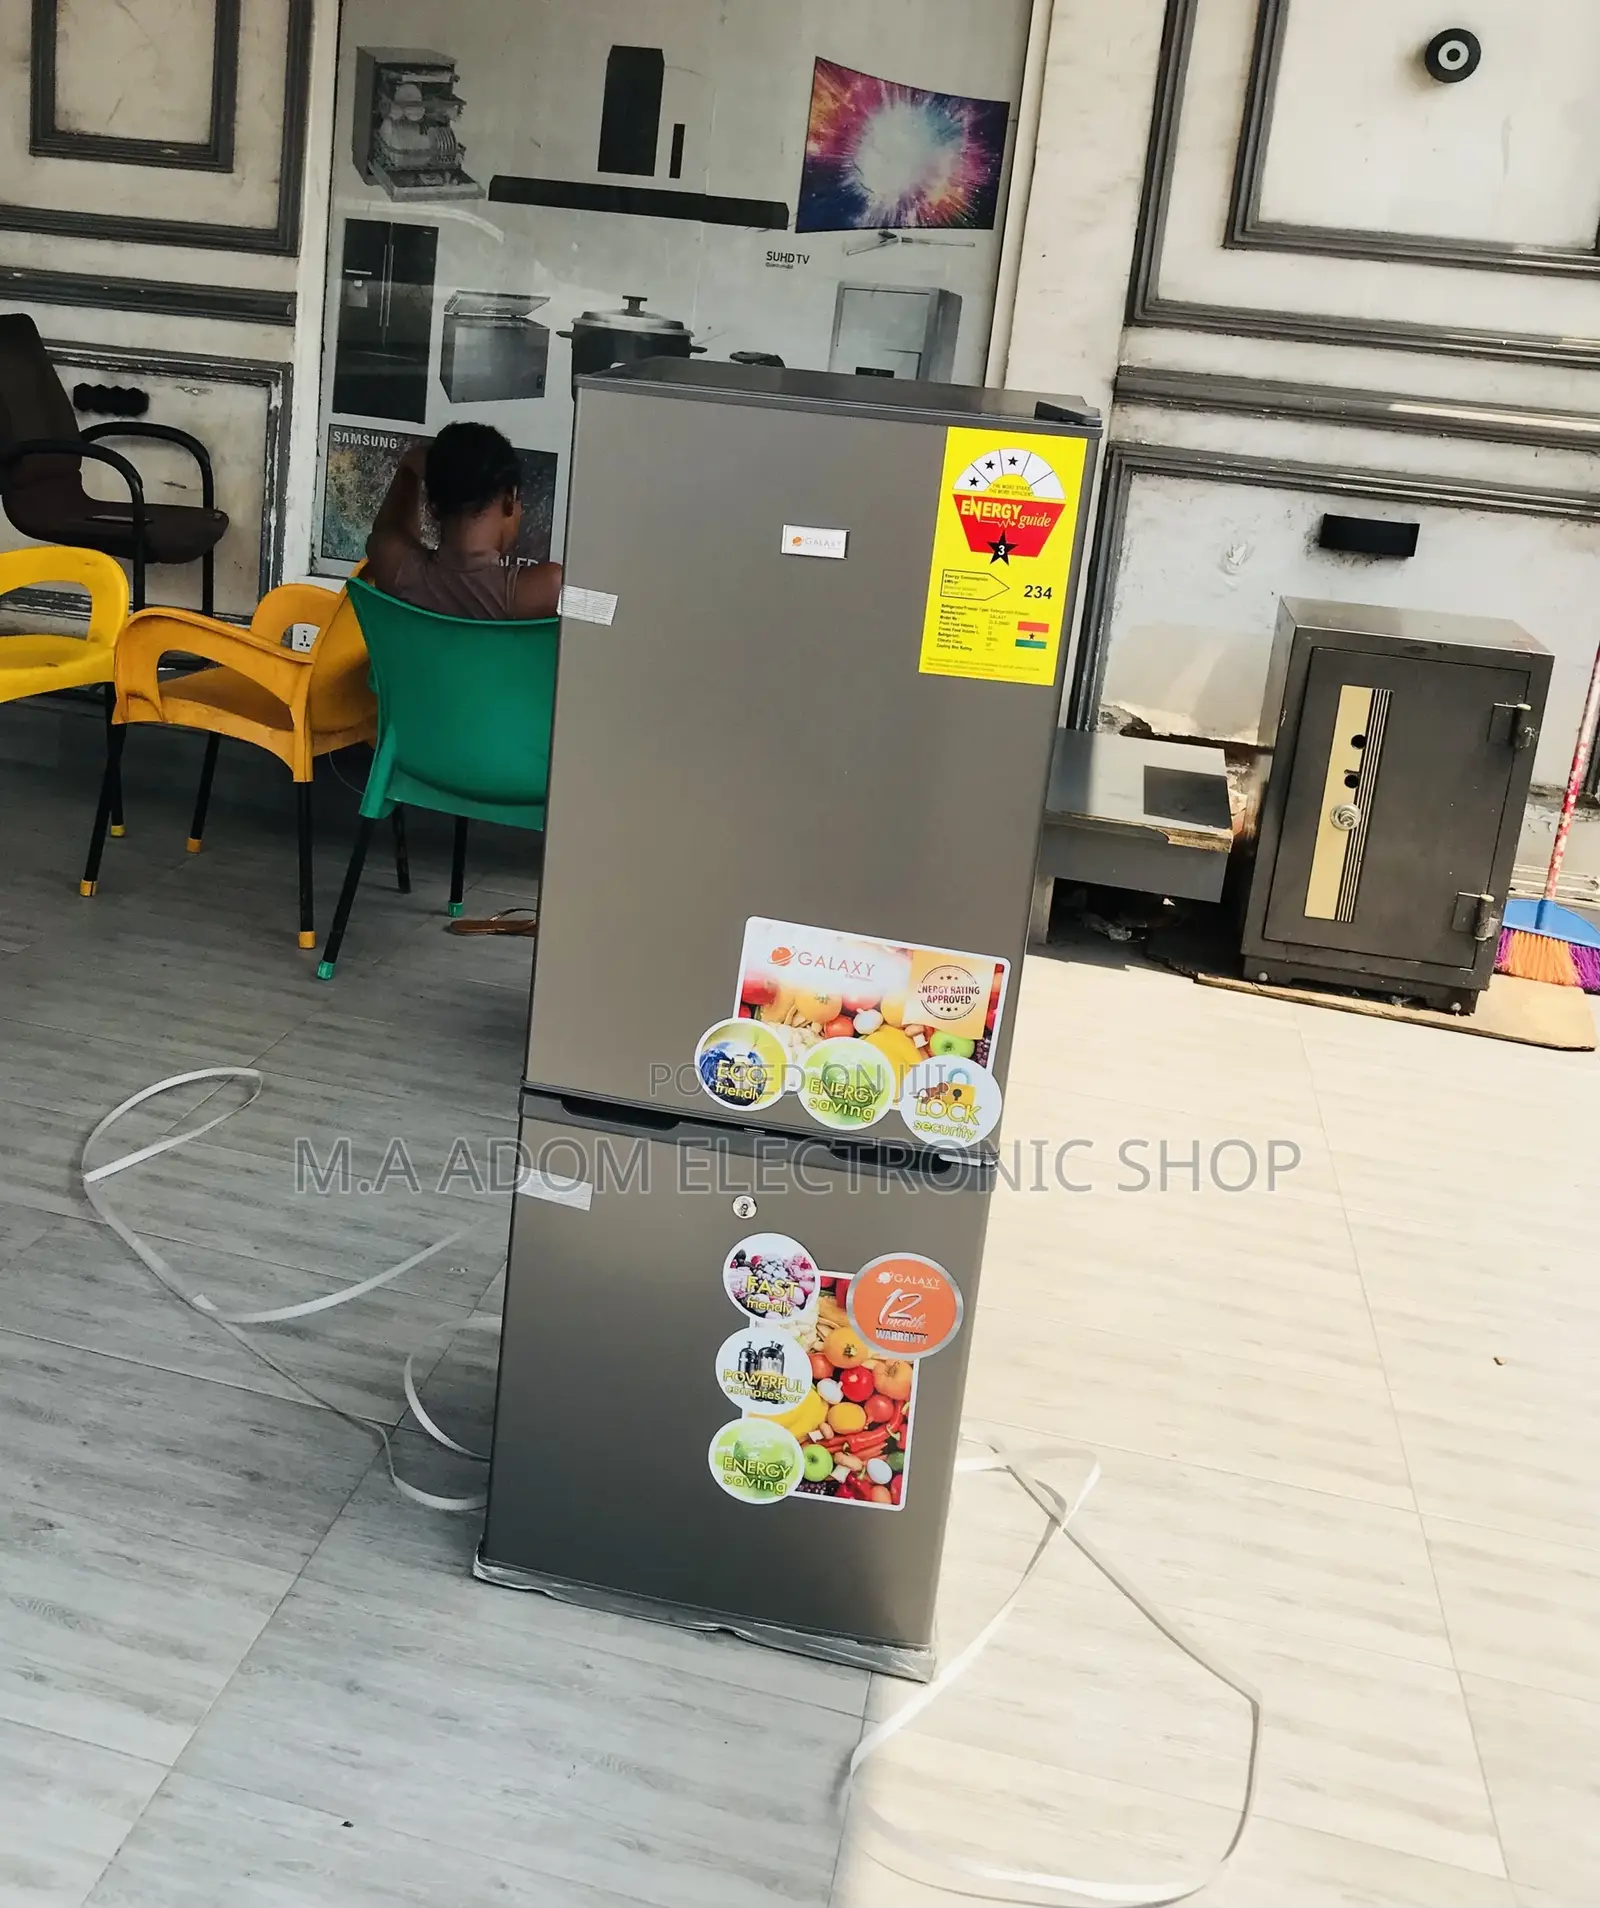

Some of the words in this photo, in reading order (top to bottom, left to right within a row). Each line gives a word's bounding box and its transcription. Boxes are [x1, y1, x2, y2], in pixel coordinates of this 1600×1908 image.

[766, 251, 795, 263] SUHD
[796, 253, 810, 264] TV
[334, 431, 397, 449] SAMSUNG
[960, 496, 1022, 522] ENERGY
[1018, 512, 1052, 529] guide
[998, 544, 1005, 556] 3
[1024, 585, 1053, 600] 234
[797, 951, 876, 977] GALAXY
[926, 994, 971, 1005] APPROVED
[950, 985, 980, 995] RATING
[716, 1059, 768, 1085] ECO
[715, 1081, 762, 1104] friendly
[808, 1078, 881, 1105] ENERGY
[808, 1097, 876, 1123] saving
[915, 1097, 982, 1125] LOCK
[913, 1120, 977, 1142] security
[746, 1274, 799, 1298] FAST
[893, 1273, 940, 1287] GALAXY
[746, 1296, 793, 1317] friendly
[878, 1288, 922, 1326] 12
[876, 1328, 928, 1344] WARRANTY
[723, 1368, 805, 1394] POWERFUL
[725, 1385, 802, 1404] compressor
[723, 1456, 793, 1480] ENERGY
[723, 1474, 787, 1496] saving
